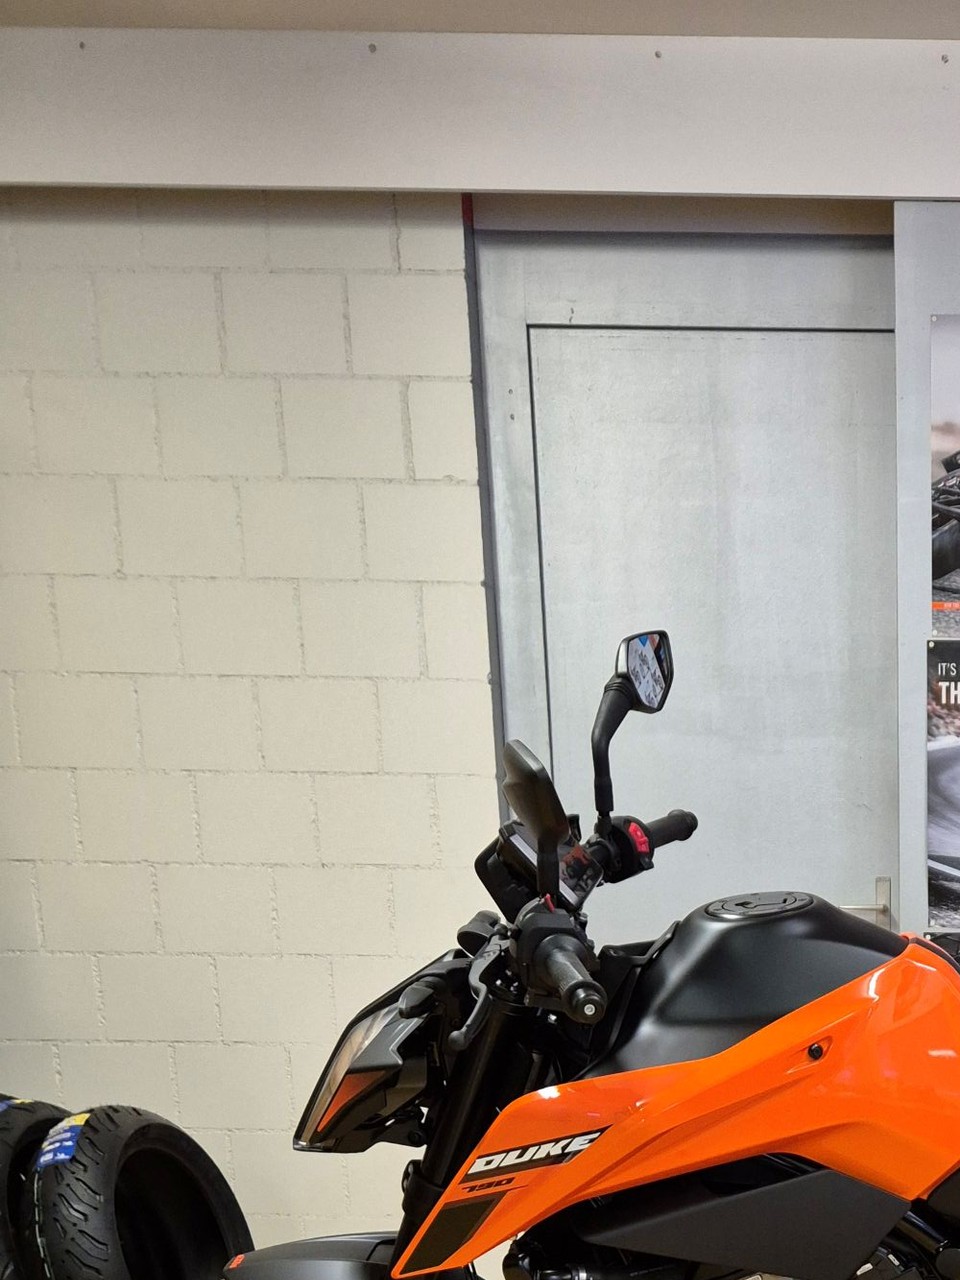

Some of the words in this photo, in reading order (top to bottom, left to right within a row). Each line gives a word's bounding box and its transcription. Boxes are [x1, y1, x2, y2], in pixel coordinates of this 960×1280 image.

[938, 663, 957, 676] IT'S
[467, 1132, 601, 1175] DUKE
[462, 1177, 515, 1193] 790
